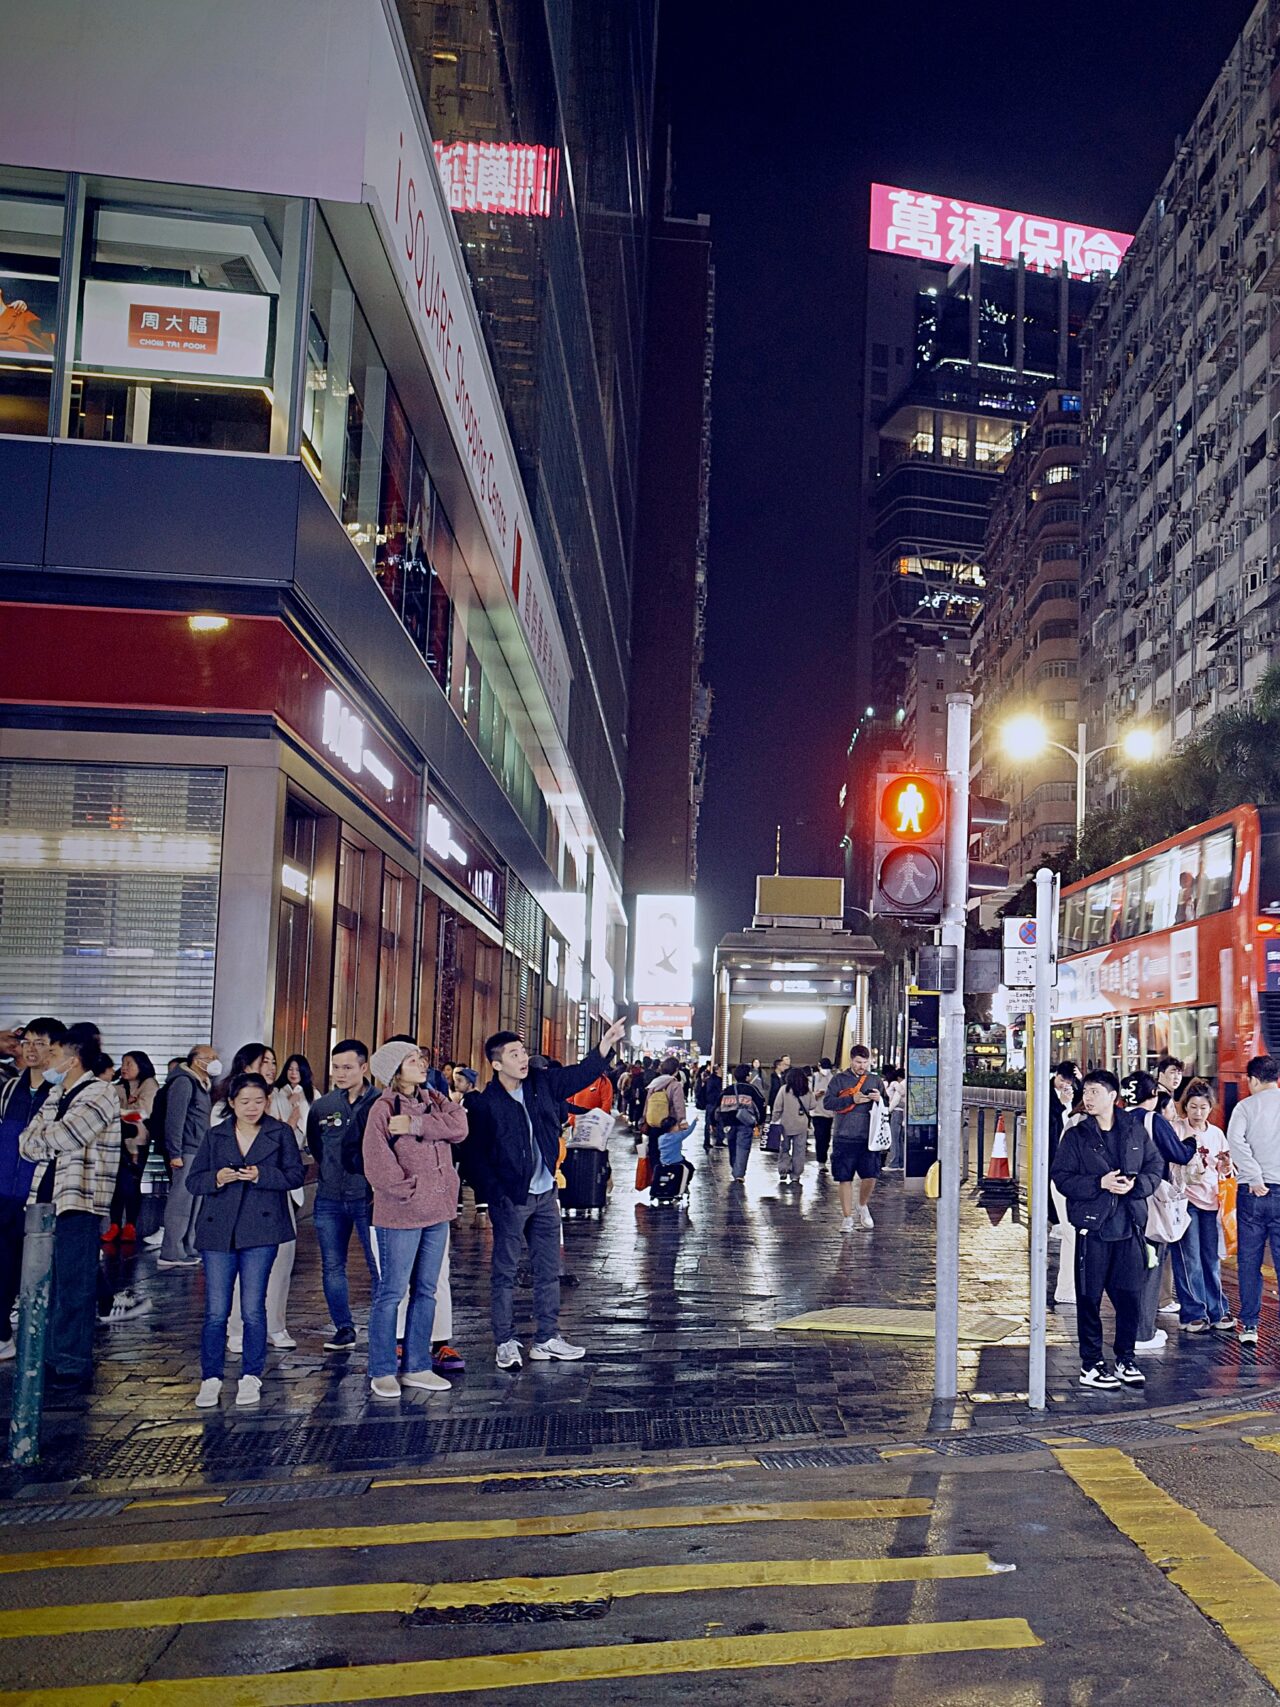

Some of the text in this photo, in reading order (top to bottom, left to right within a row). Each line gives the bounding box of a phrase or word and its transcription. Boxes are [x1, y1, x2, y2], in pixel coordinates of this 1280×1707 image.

[886, 190, 1122, 279] 萬通保險
[139, 338, 207, 350] CHOW TAI FOOK
[141, 311, 208, 334] 周大福
[455, 344, 488, 500] Shopping
[487, 452, 508, 548] Centre
